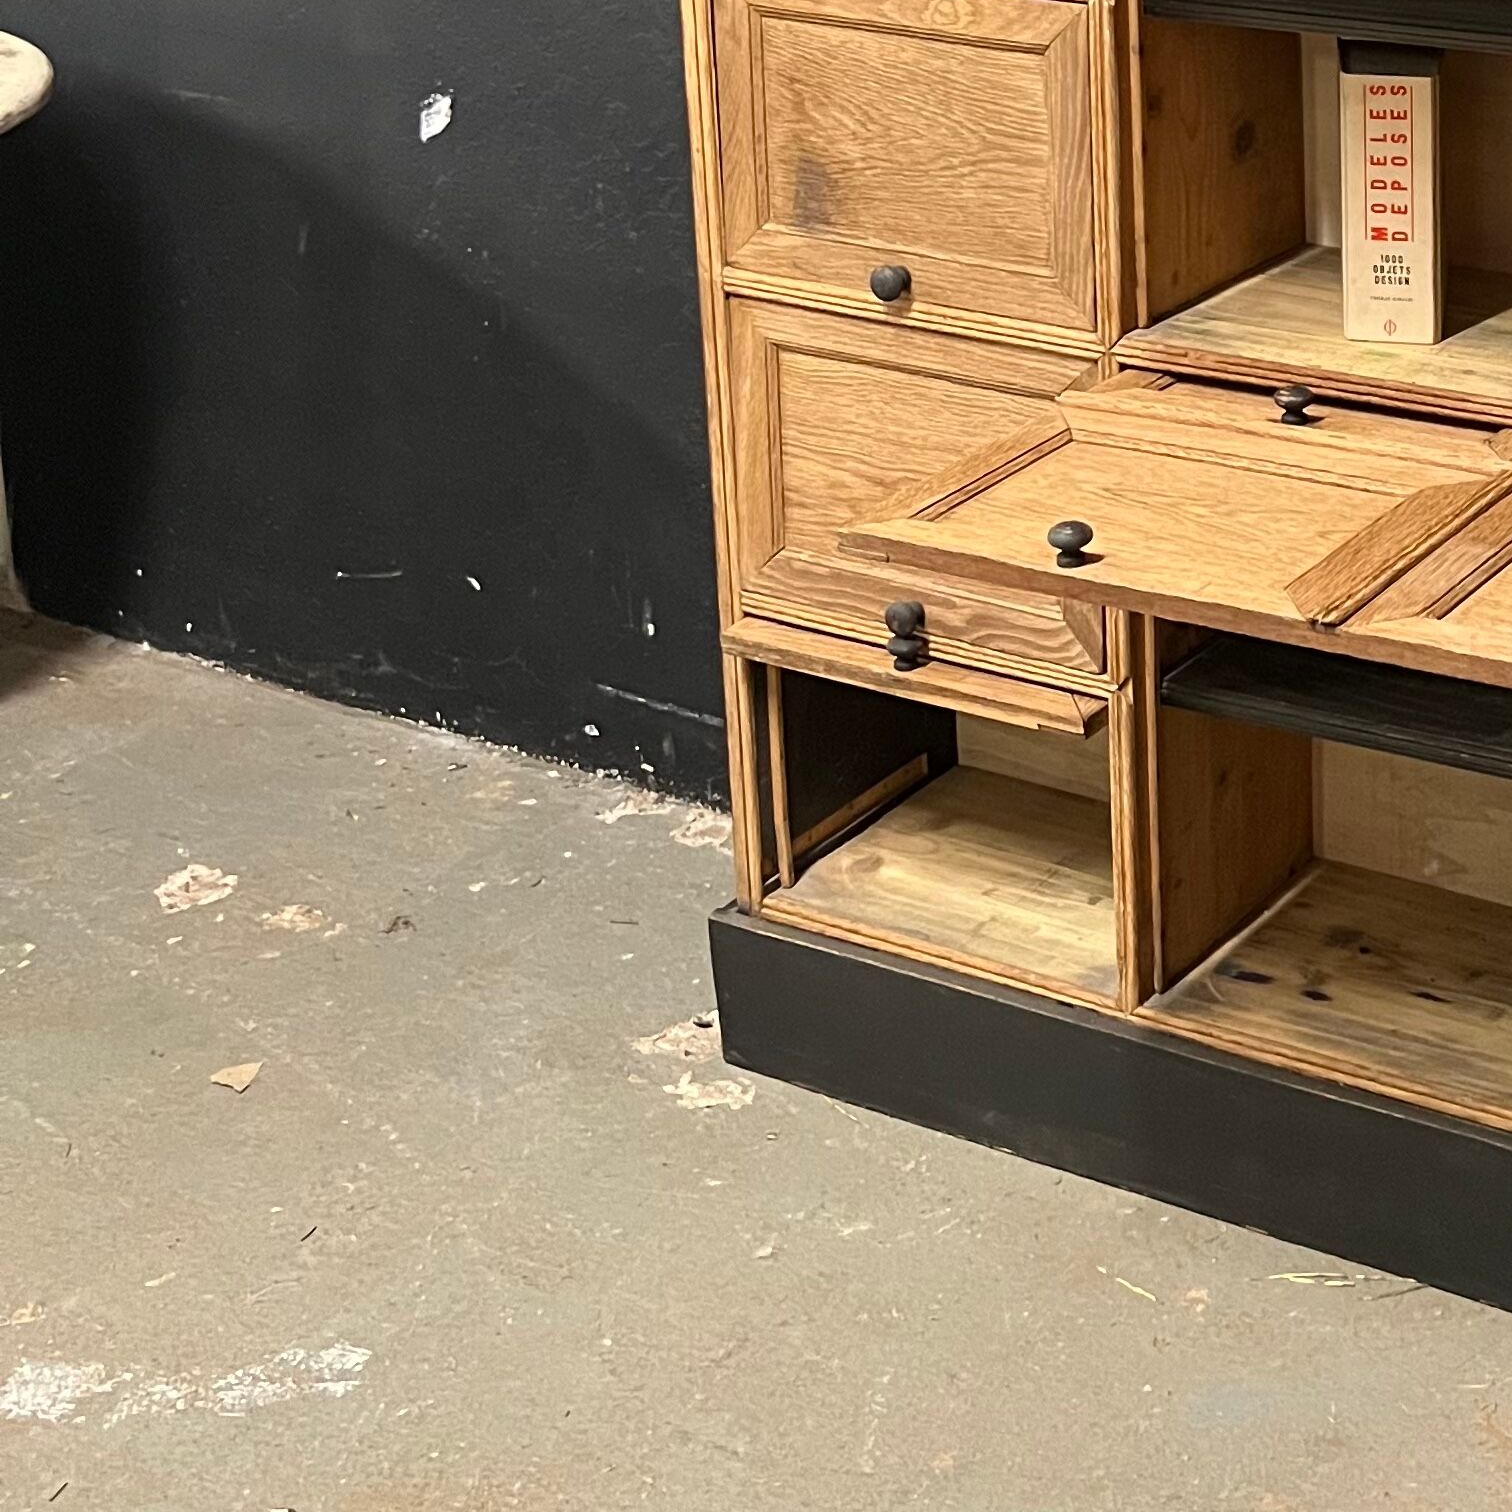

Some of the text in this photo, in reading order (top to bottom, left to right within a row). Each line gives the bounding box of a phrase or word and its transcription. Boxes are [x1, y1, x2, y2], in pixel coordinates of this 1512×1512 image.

[1369, 85, 1388, 242] MODELES
[1390, 85, 1408, 242] DEPOSES
[1380, 253, 1404, 264] 1000
[1373, 264, 1411, 275] OBJETS
[1374, 275, 1410, 285] DESIGN
